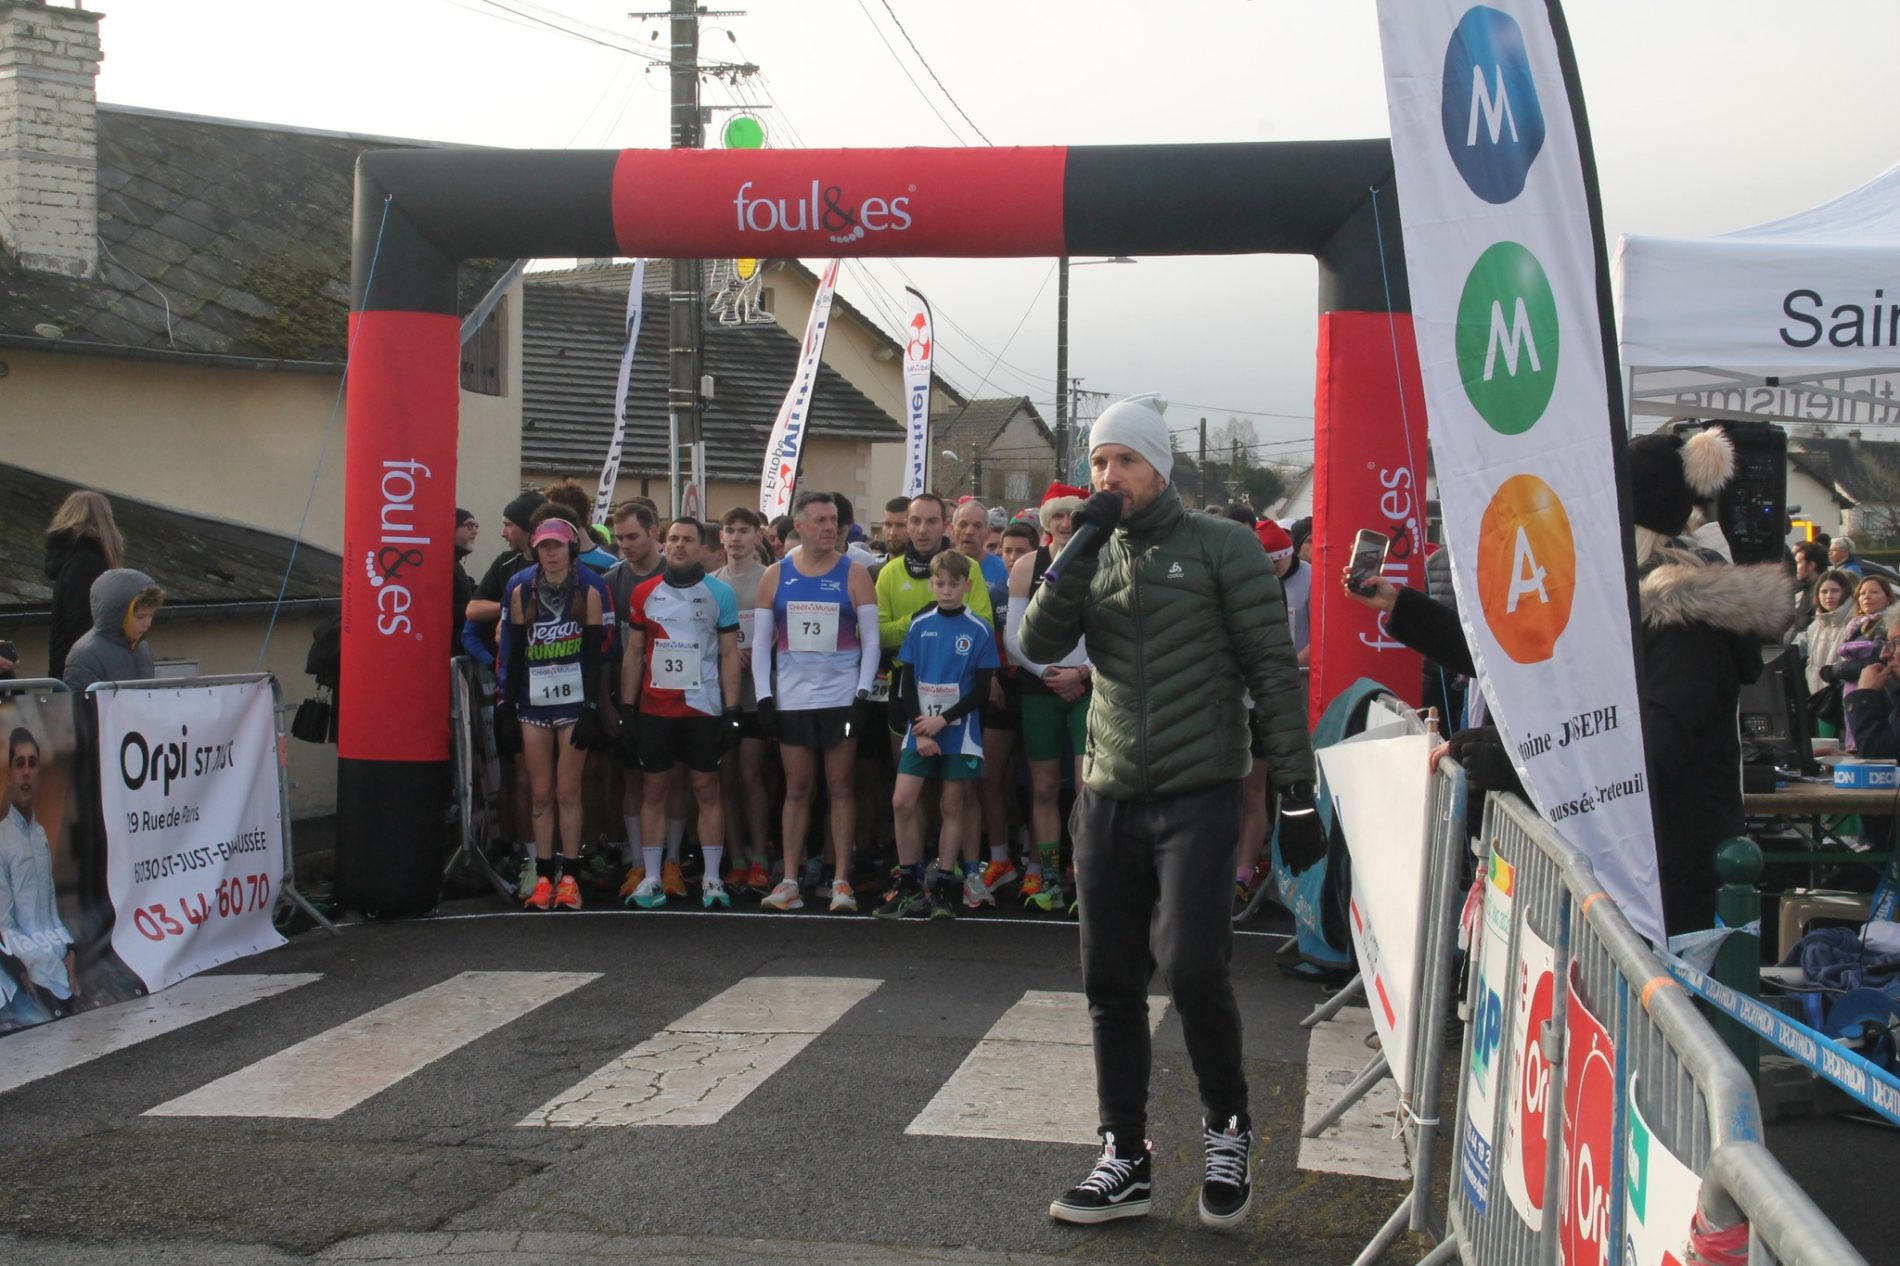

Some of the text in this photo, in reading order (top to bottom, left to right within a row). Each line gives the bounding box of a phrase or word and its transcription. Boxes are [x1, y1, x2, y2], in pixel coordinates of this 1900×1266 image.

[1359, 466, 1411, 653] fl&es
[803, 622, 821, 635] 73
[665, 659, 684, 672] 33
[543, 684, 571, 698] 118
[928, 704, 942, 717] 17
[120, 724, 188, 796] Orpi
[1548, 772, 1643, 823] aussée reteuil
[142, 810, 165, 831] Rue
[166, 806, 180, 828] de
[133, 903, 184, 942] 03
[217, 876, 244, 918] 60
[246, 872, 270, 913] 70
[1778, 1022, 1817, 1067] DECATHLON
[1821, 1046, 1867, 1098] DECATHLON
